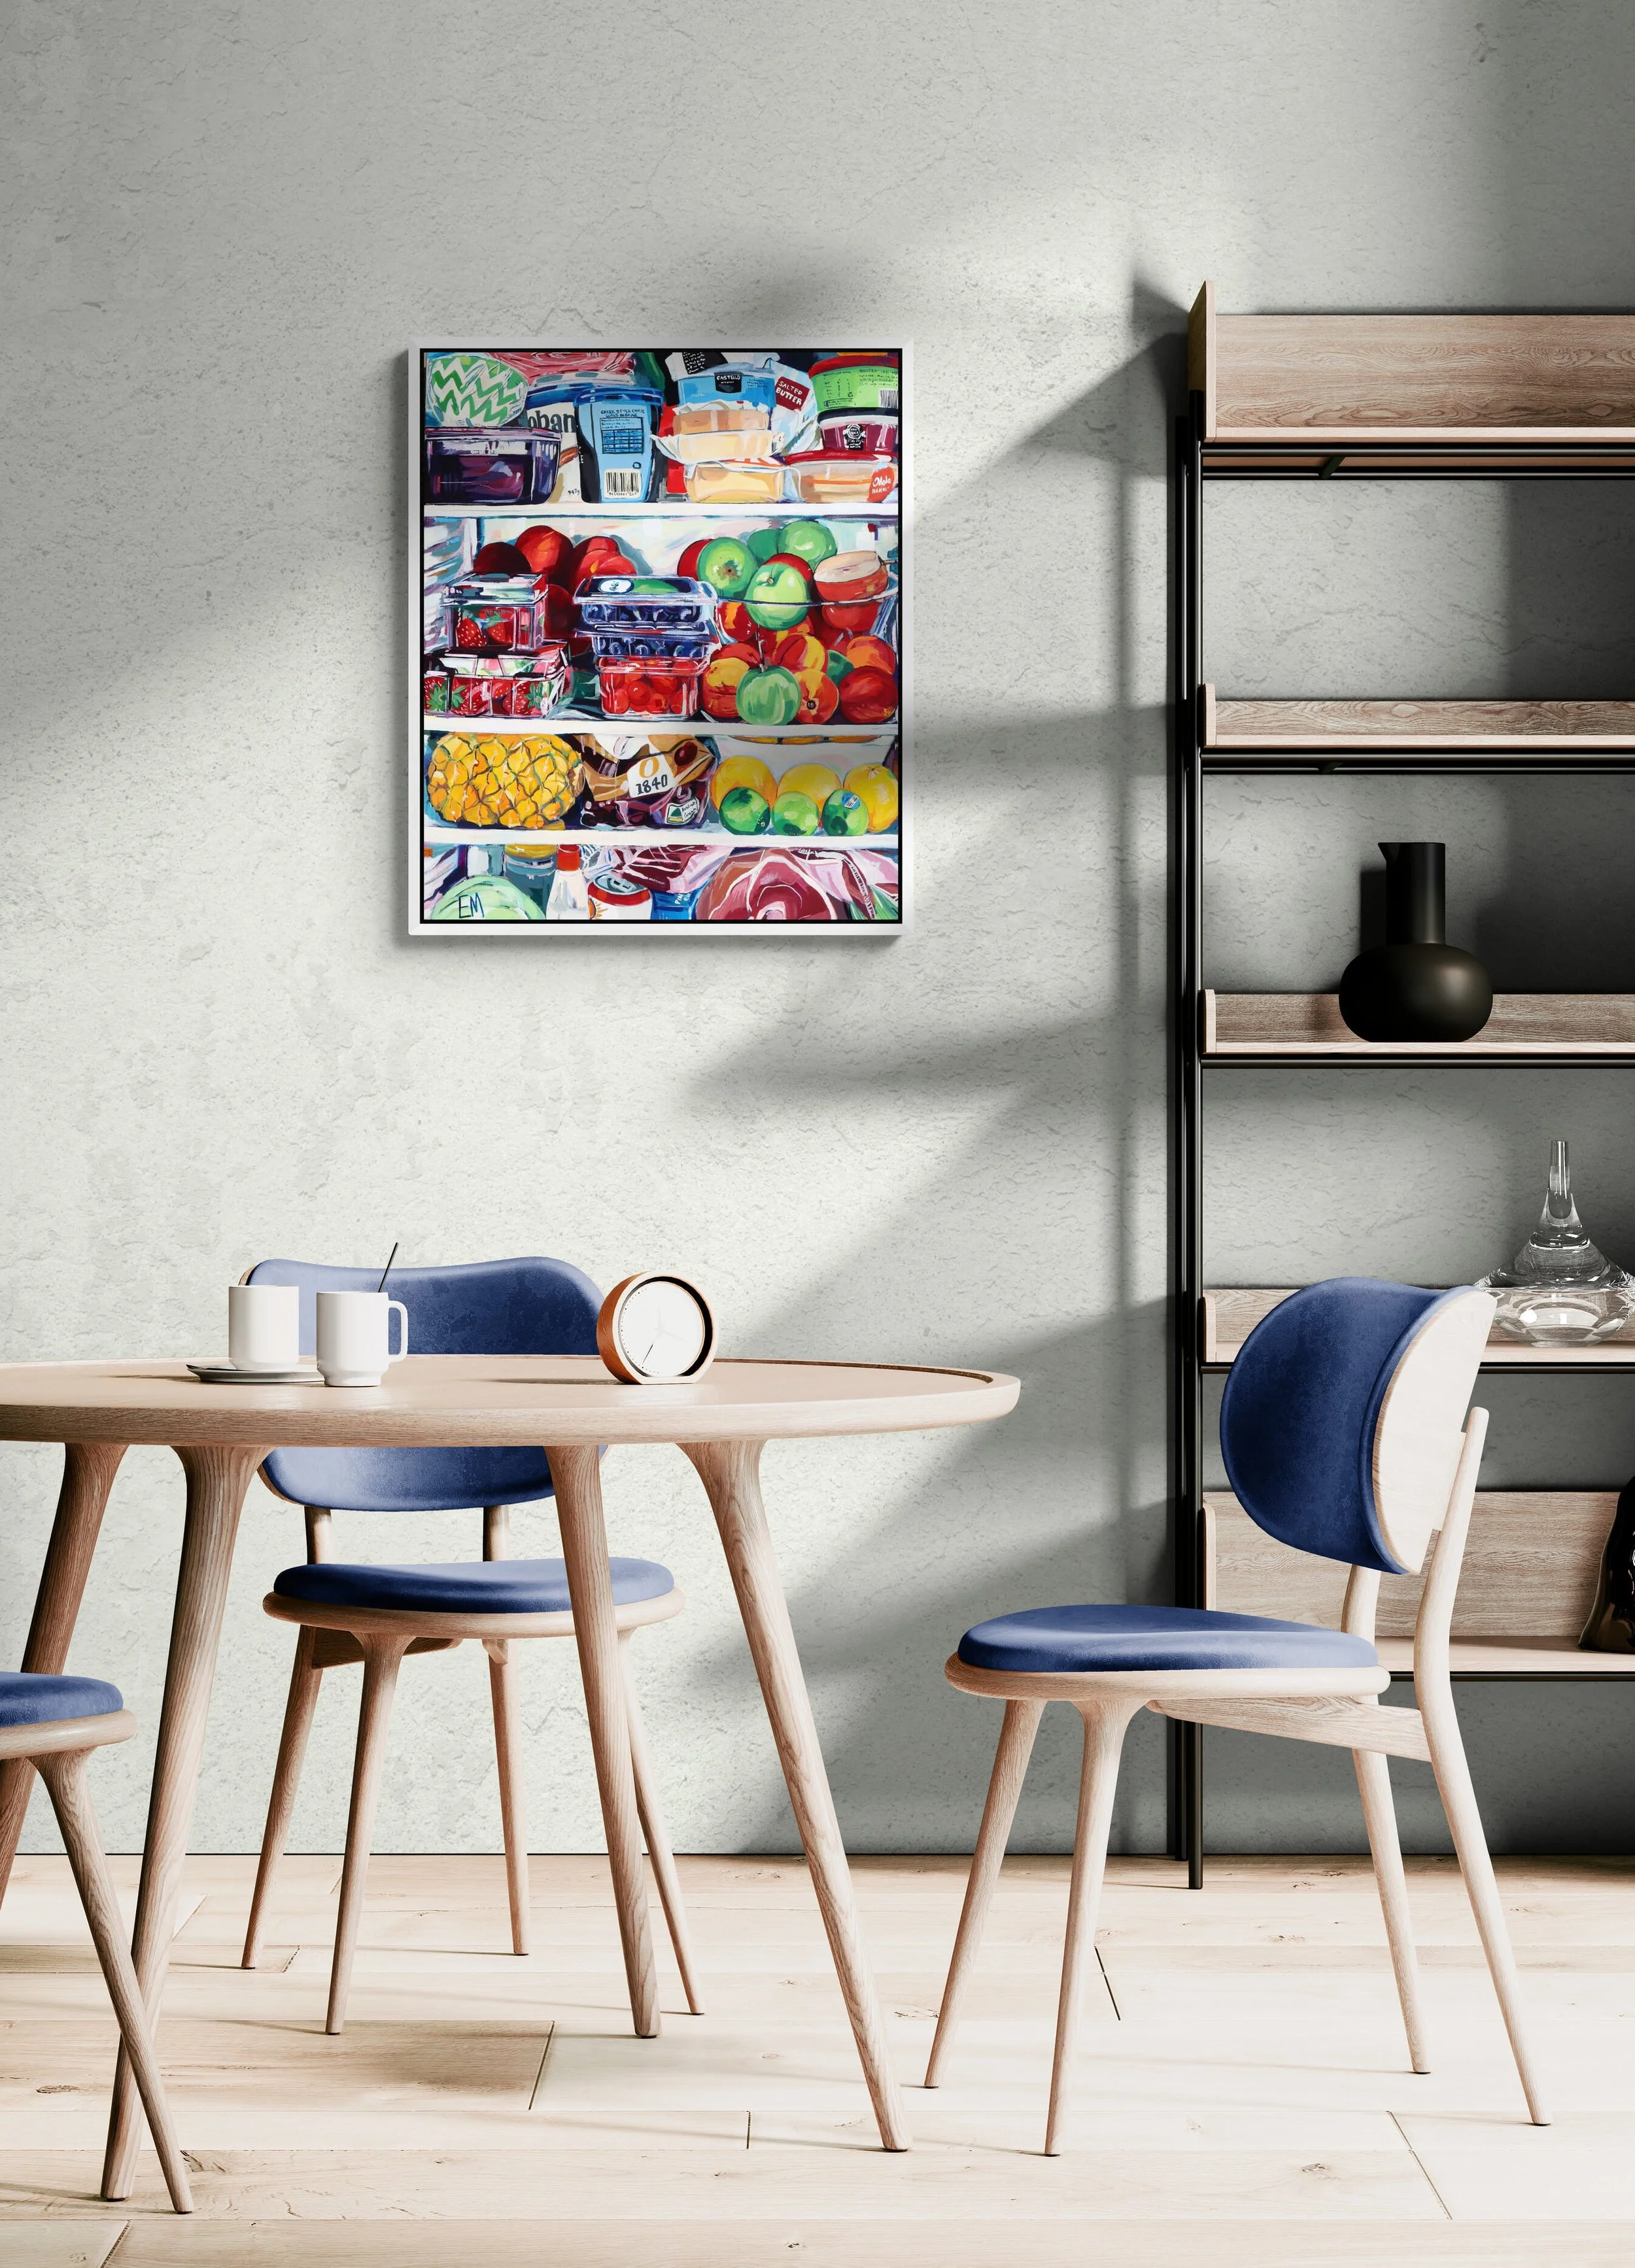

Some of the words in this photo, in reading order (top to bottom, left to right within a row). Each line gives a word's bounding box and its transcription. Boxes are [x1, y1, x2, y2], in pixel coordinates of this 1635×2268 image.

[776, 387, 802, 405] BUTTER
[779, 381, 802, 395] SALTED
[636, 774, 668, 795] 1840
[458, 892, 485, 919] EM
